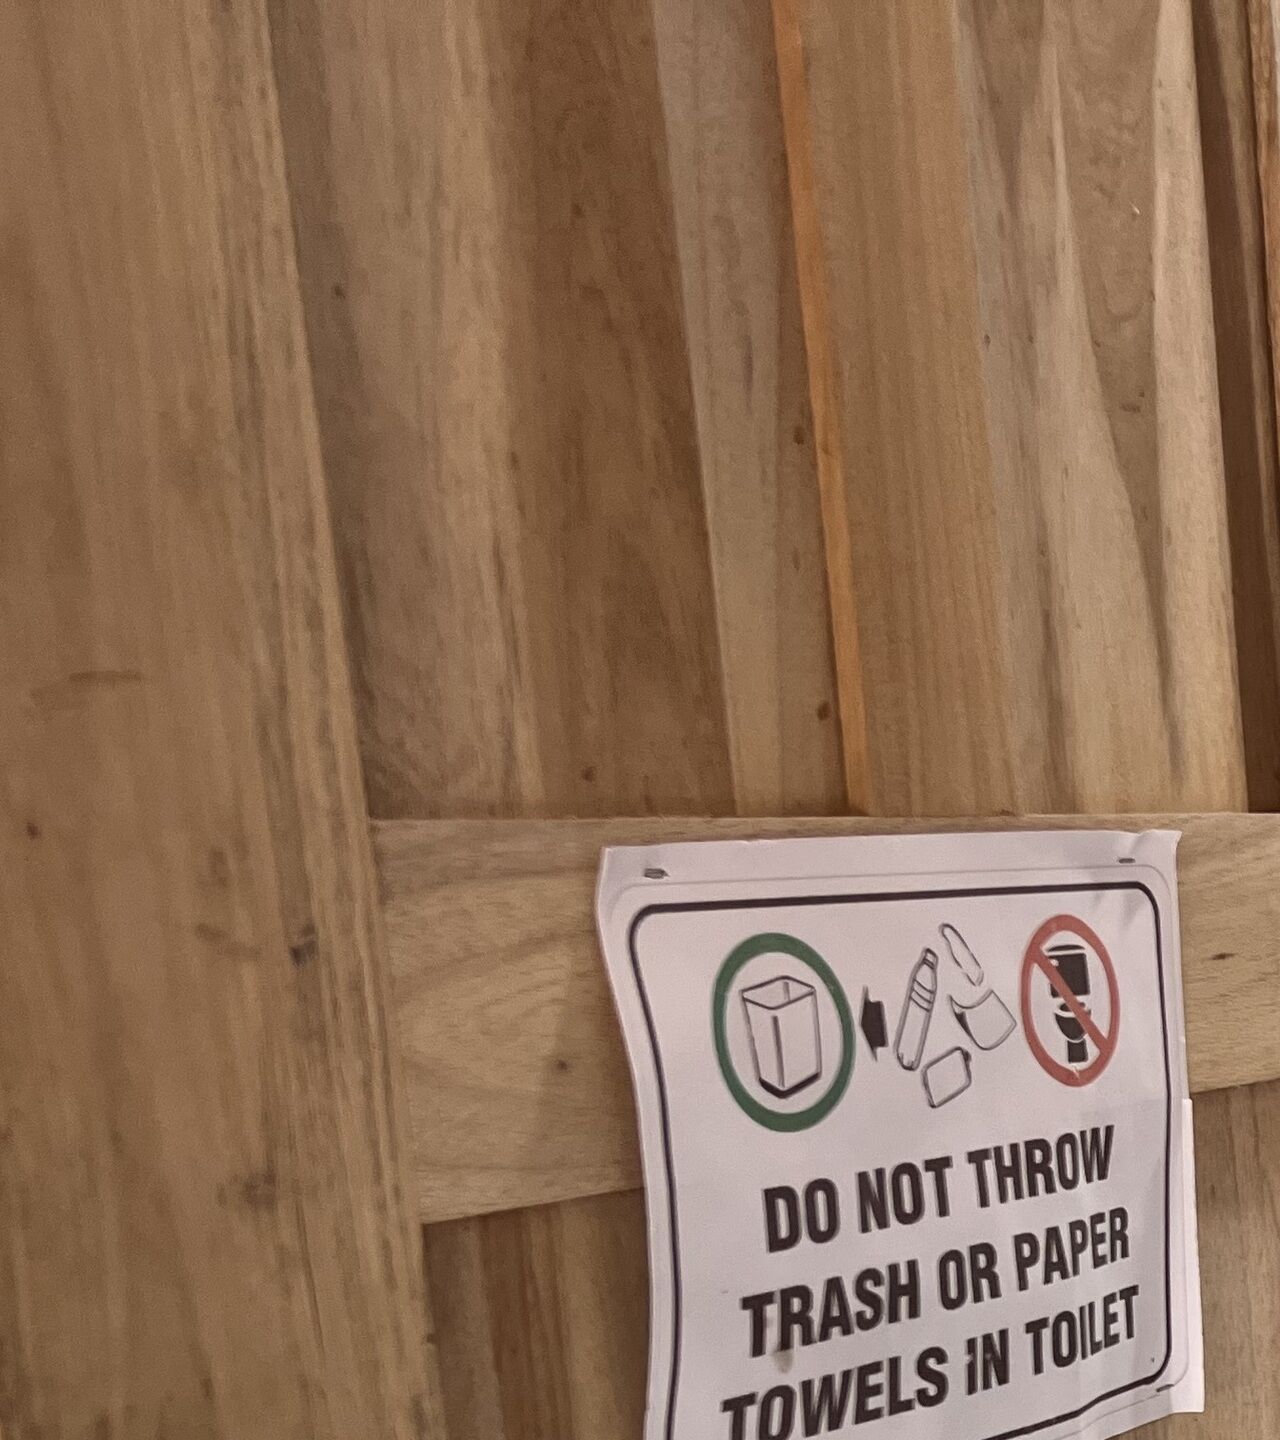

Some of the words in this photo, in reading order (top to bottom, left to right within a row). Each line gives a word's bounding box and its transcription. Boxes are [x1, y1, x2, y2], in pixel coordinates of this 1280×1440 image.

[763, 1178, 840, 1253] DO
[856, 1156, 952, 1233] NOT
[967, 1125, 1114, 1208] THROW
[740, 1259, 921, 1358] TRASH
[937, 1242, 1001, 1310] OR
[1013, 1207, 1130, 1291] PAPER
[965, 1328, 1010, 1395] IN
[1025, 1285, 1139, 1375] TOILET
